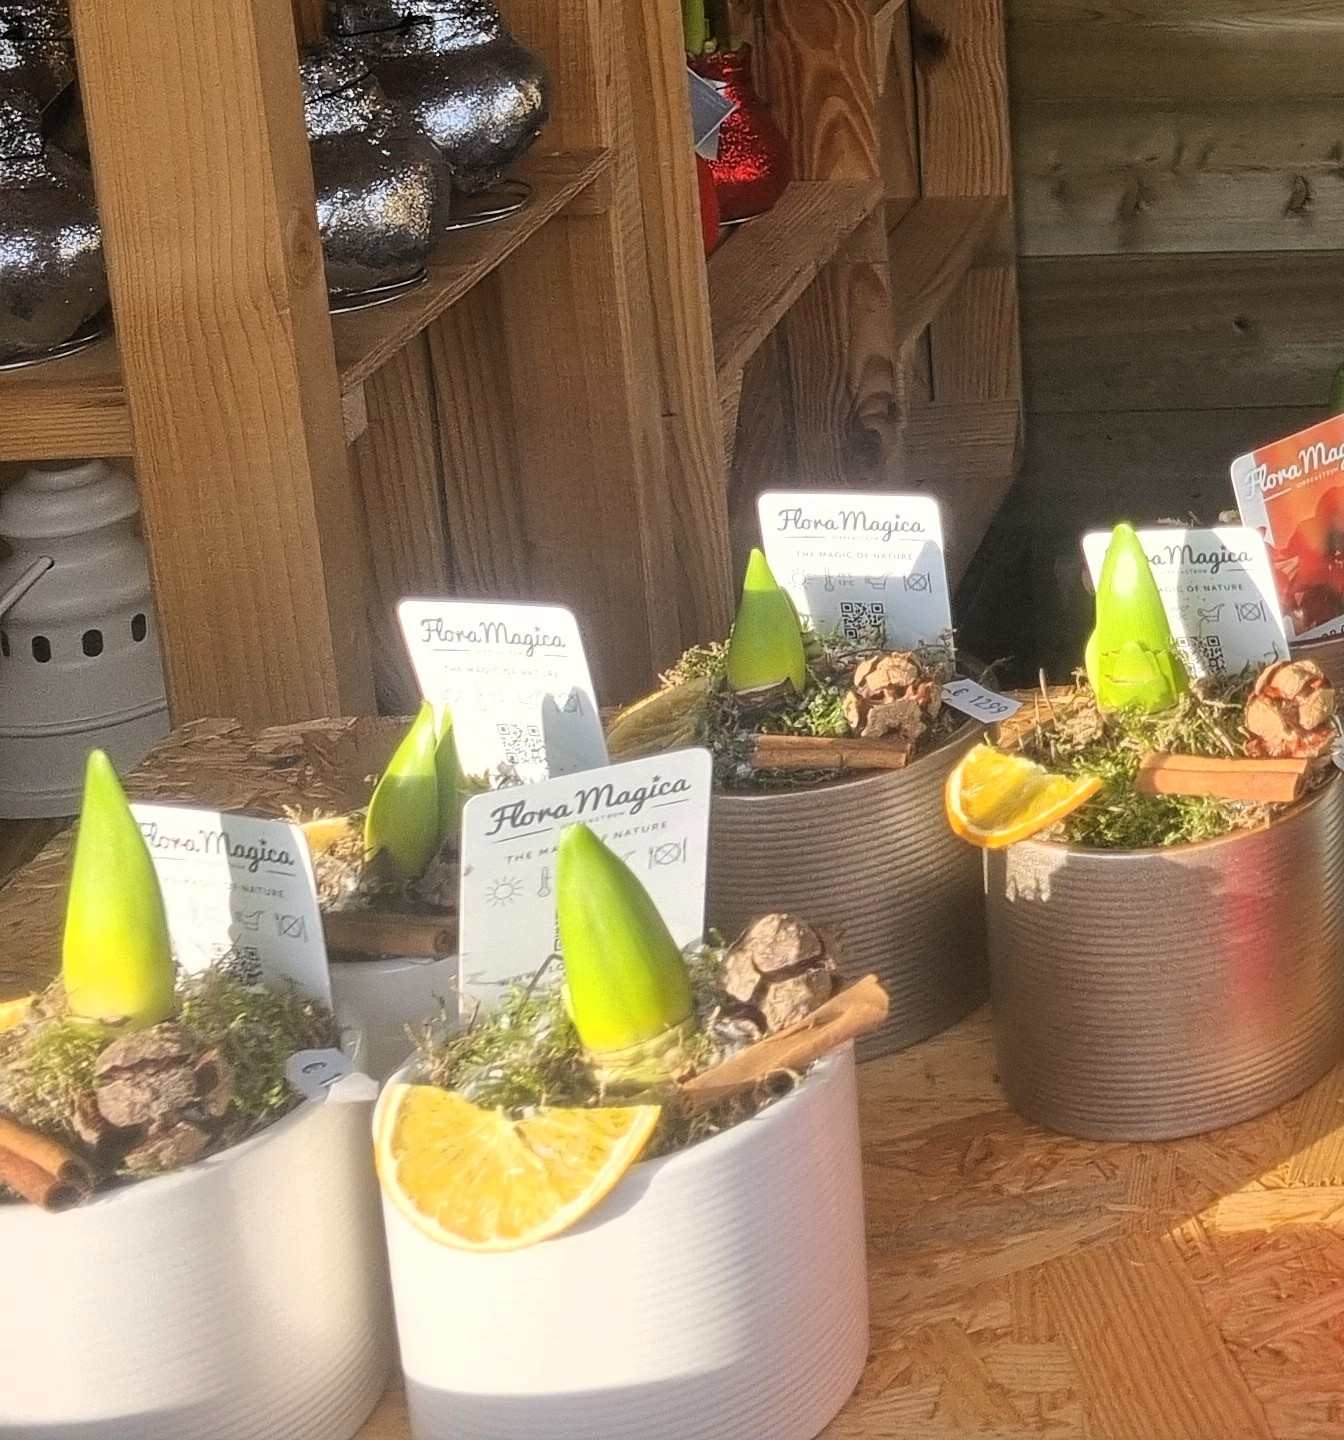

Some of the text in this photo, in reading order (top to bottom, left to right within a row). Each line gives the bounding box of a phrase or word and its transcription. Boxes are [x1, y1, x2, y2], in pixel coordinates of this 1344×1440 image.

[1244, 462, 1302, 500] Flora
[777, 507, 926, 543] Flora Magica
[1164, 544, 1254, 574] Magica
[1202, 583, 1244, 593] NATURE
[420, 617, 567, 658] Flora Magica
[485, 774, 693, 837] Flora Magica
[612, 821, 669, 841] NATURE
[198, 829, 296, 873] Magica
[504, 852, 532, 865] THE
